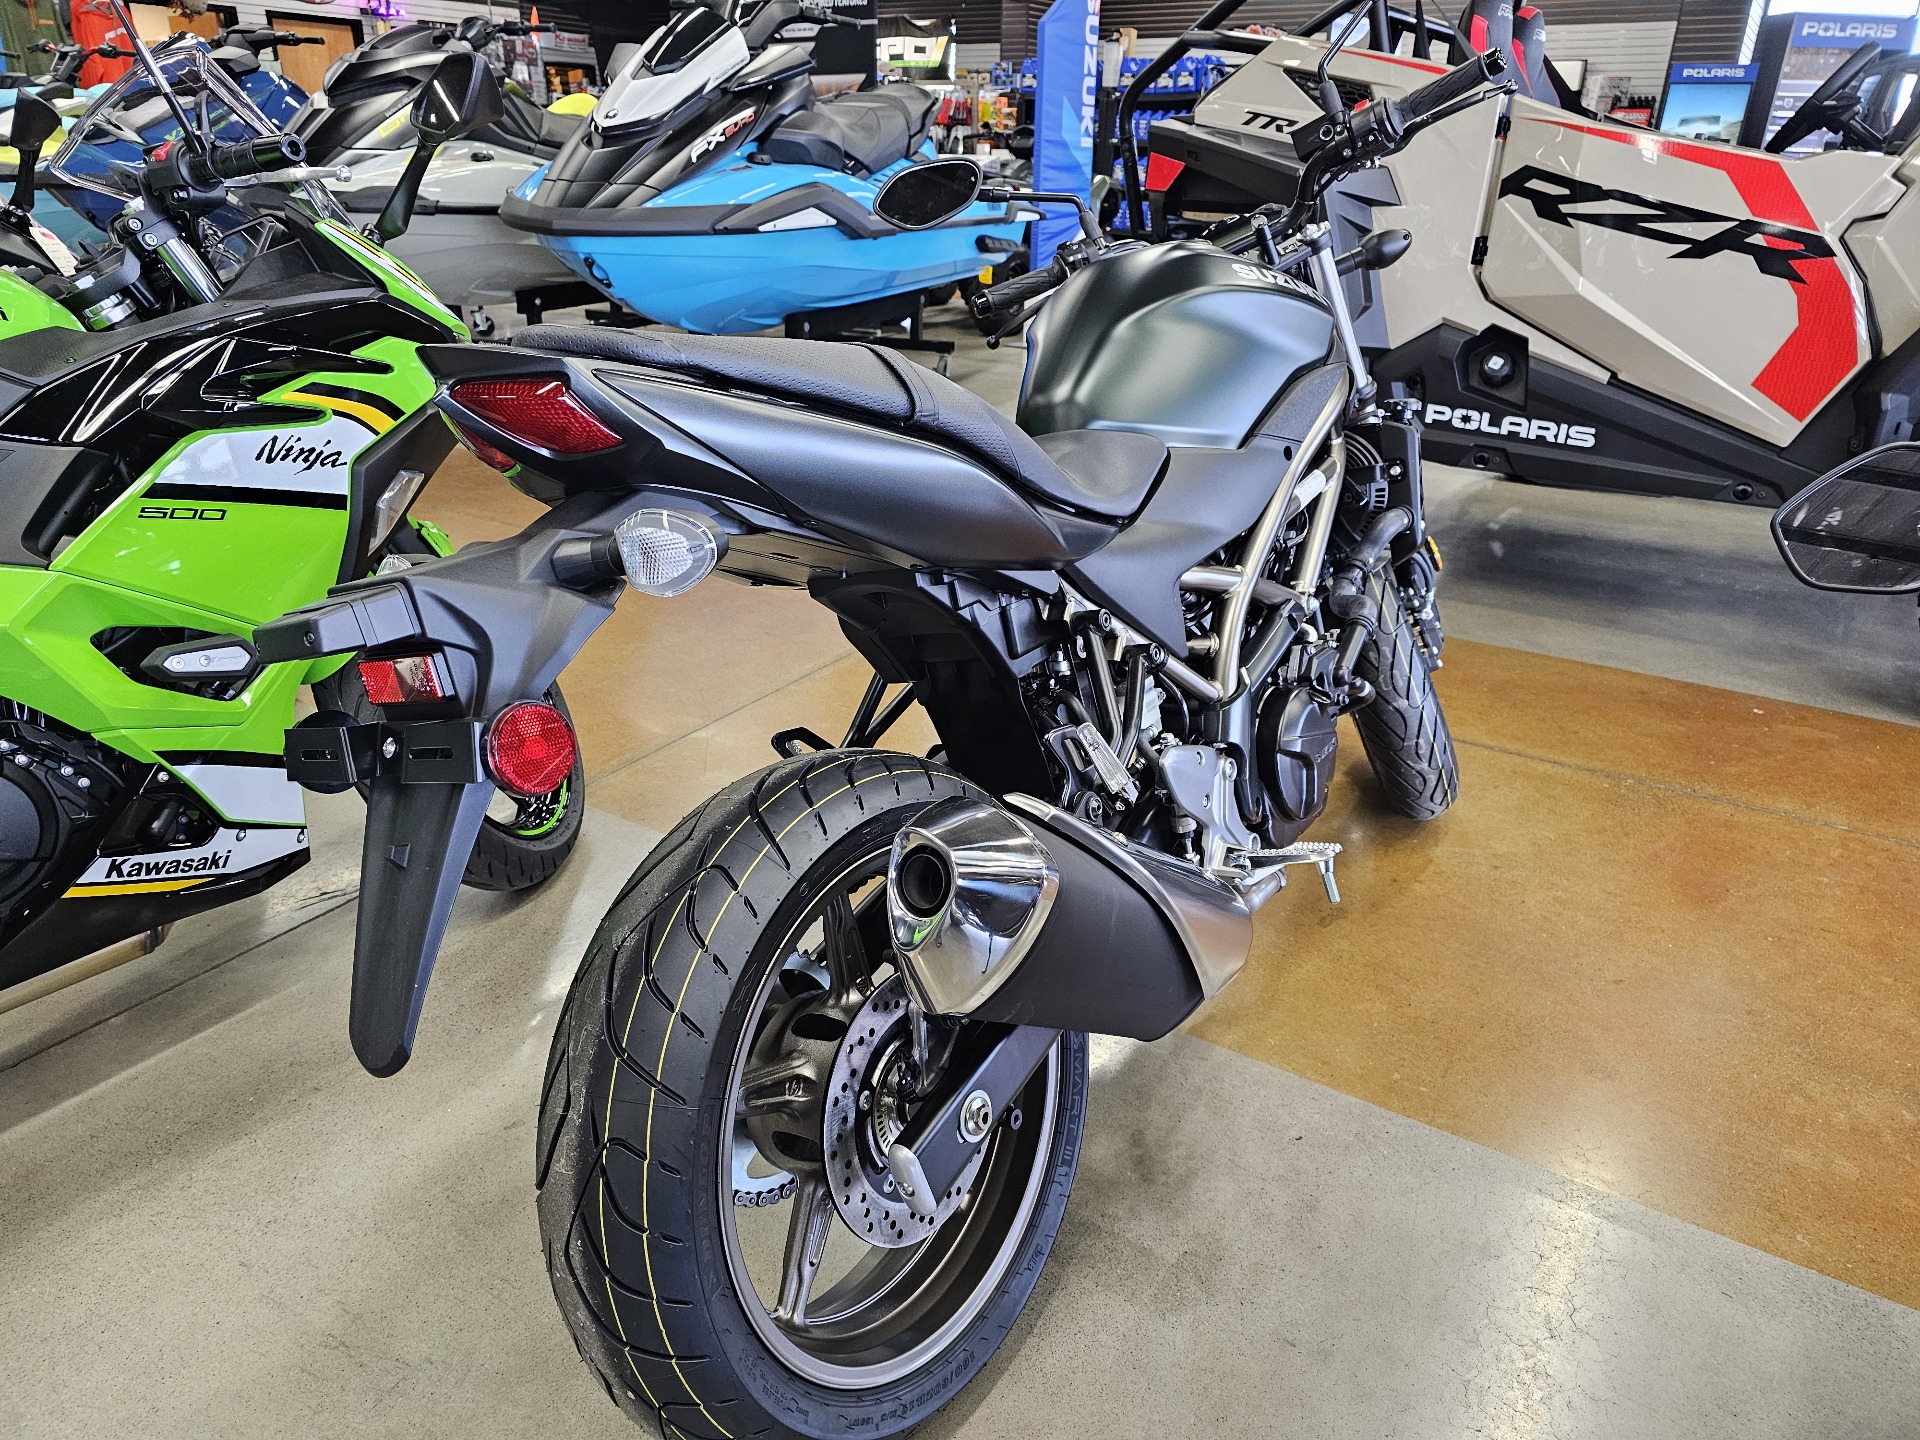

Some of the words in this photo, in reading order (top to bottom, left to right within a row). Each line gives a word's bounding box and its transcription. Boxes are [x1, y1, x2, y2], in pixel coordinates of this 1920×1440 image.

[1802, 21, 1898, 40] POLARIS
[1682, 67, 1745, 79] POLARIS
[690, 128, 726, 163] FX
[1498, 164, 1838, 286] RZR
[1424, 403, 1597, 448] POLARIS
[255, 434, 347, 475] Ninja
[138, 507, 227, 521] 500
[104, 849, 232, 879] Kawasaki
